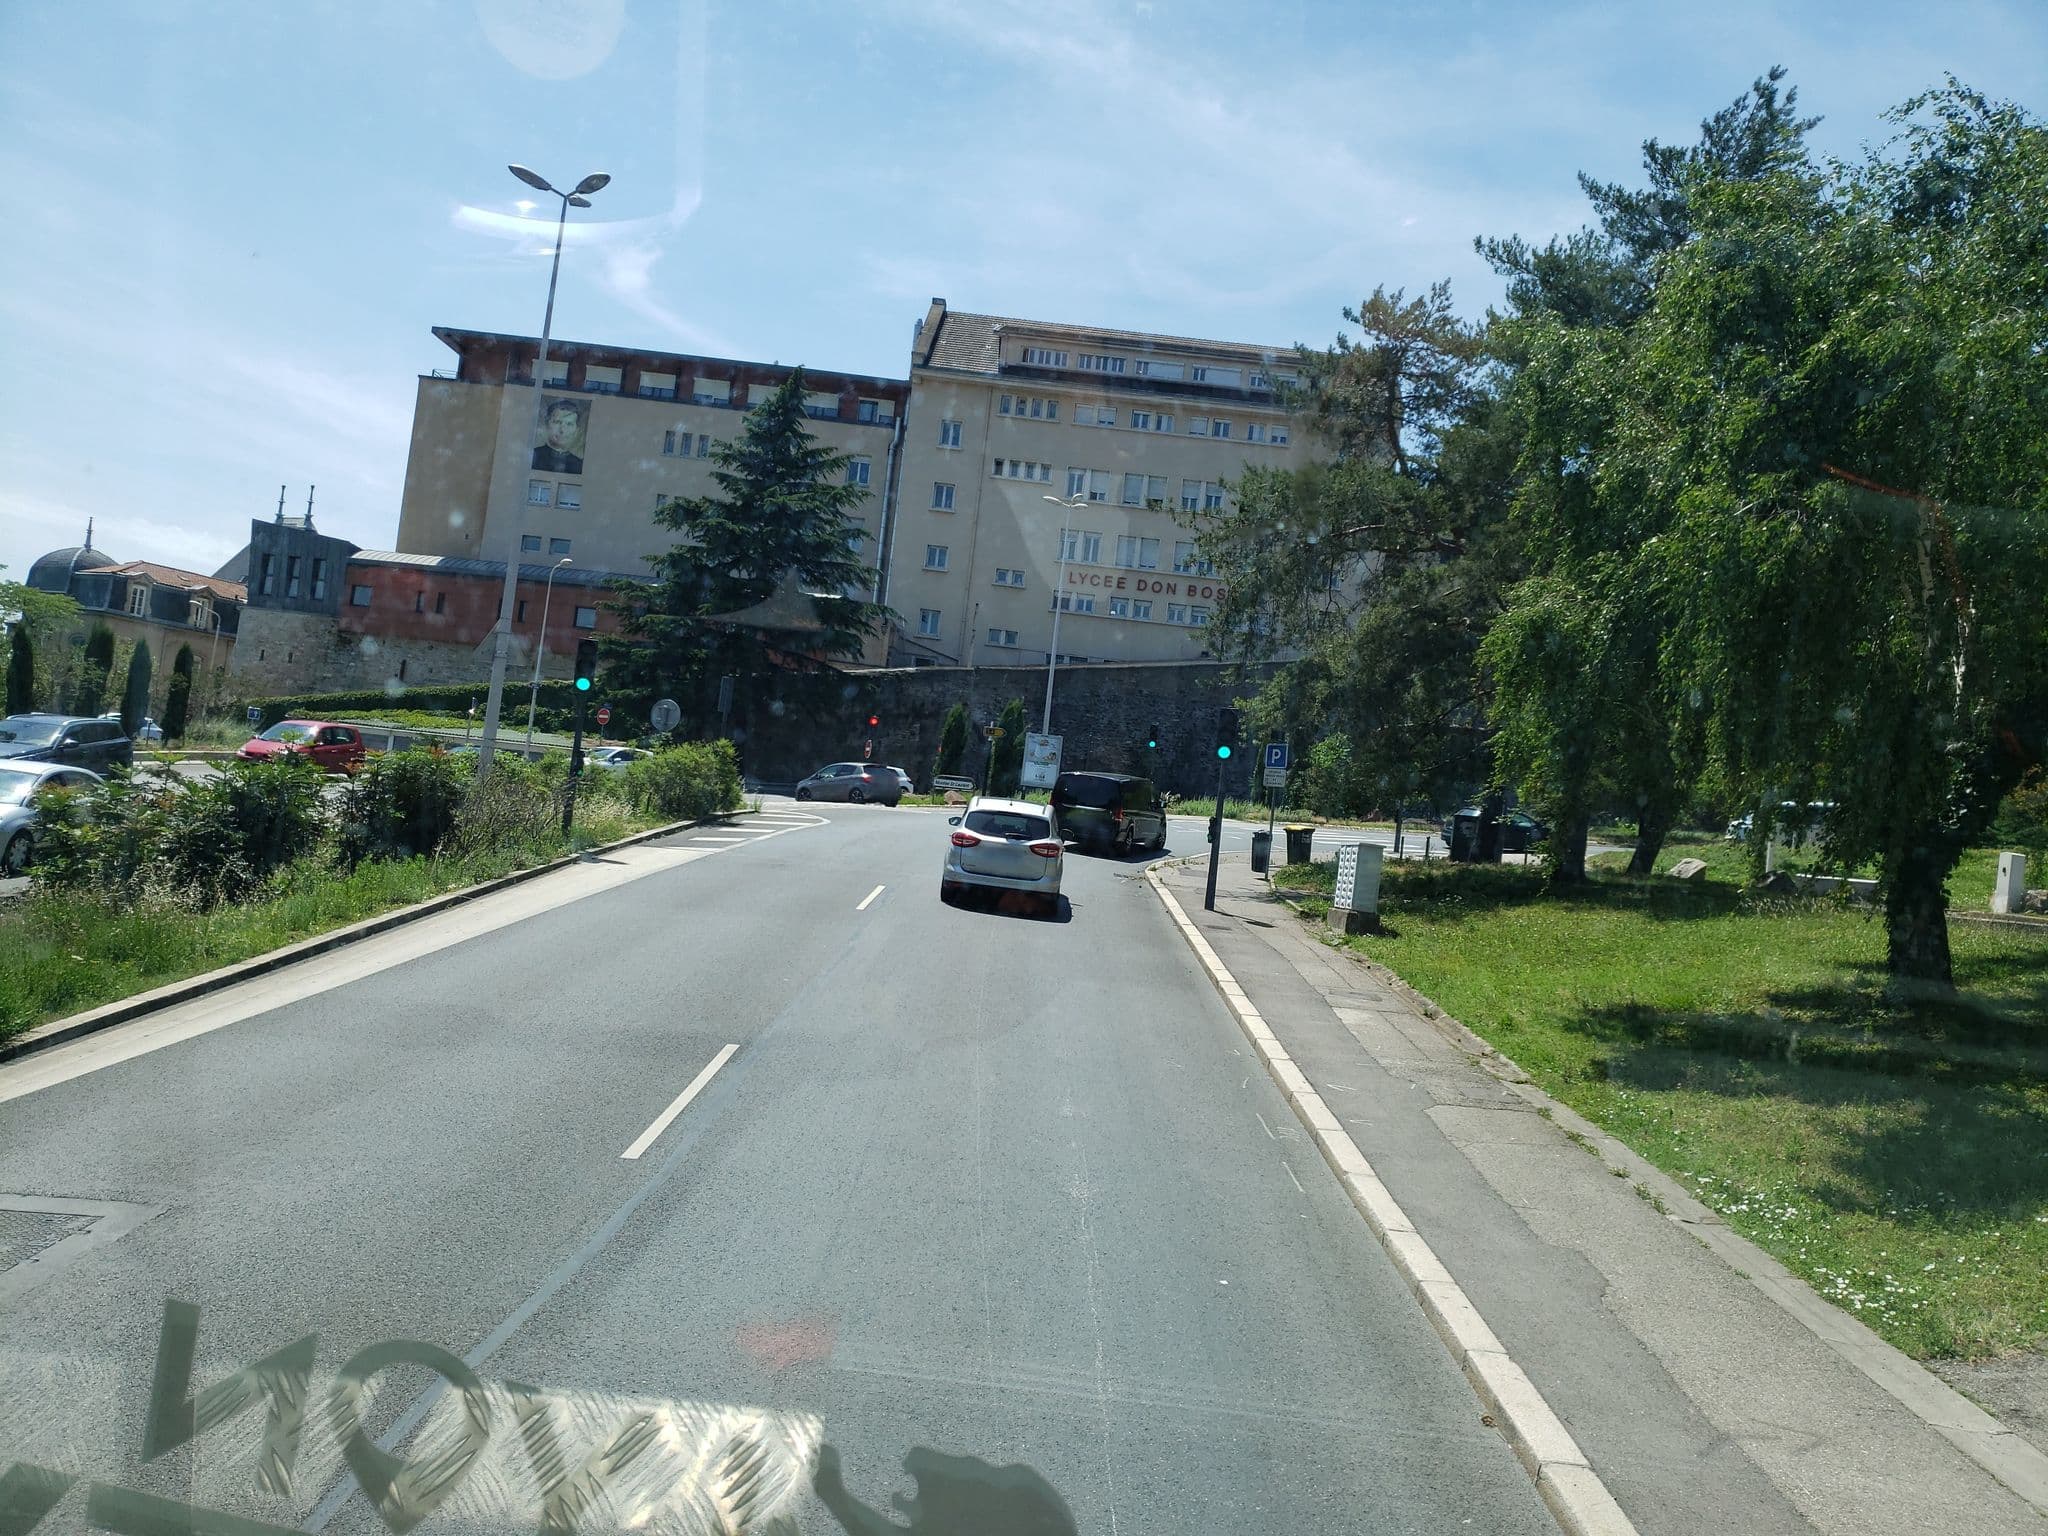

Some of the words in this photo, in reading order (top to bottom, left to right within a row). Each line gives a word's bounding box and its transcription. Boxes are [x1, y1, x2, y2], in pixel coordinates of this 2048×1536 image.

[1069, 572, 1127, 589] LYCEE
[1137, 579, 1177, 595] DON
[1187, 585, 1227, 600] BOS
[1271, 748, 1281, 764] P
